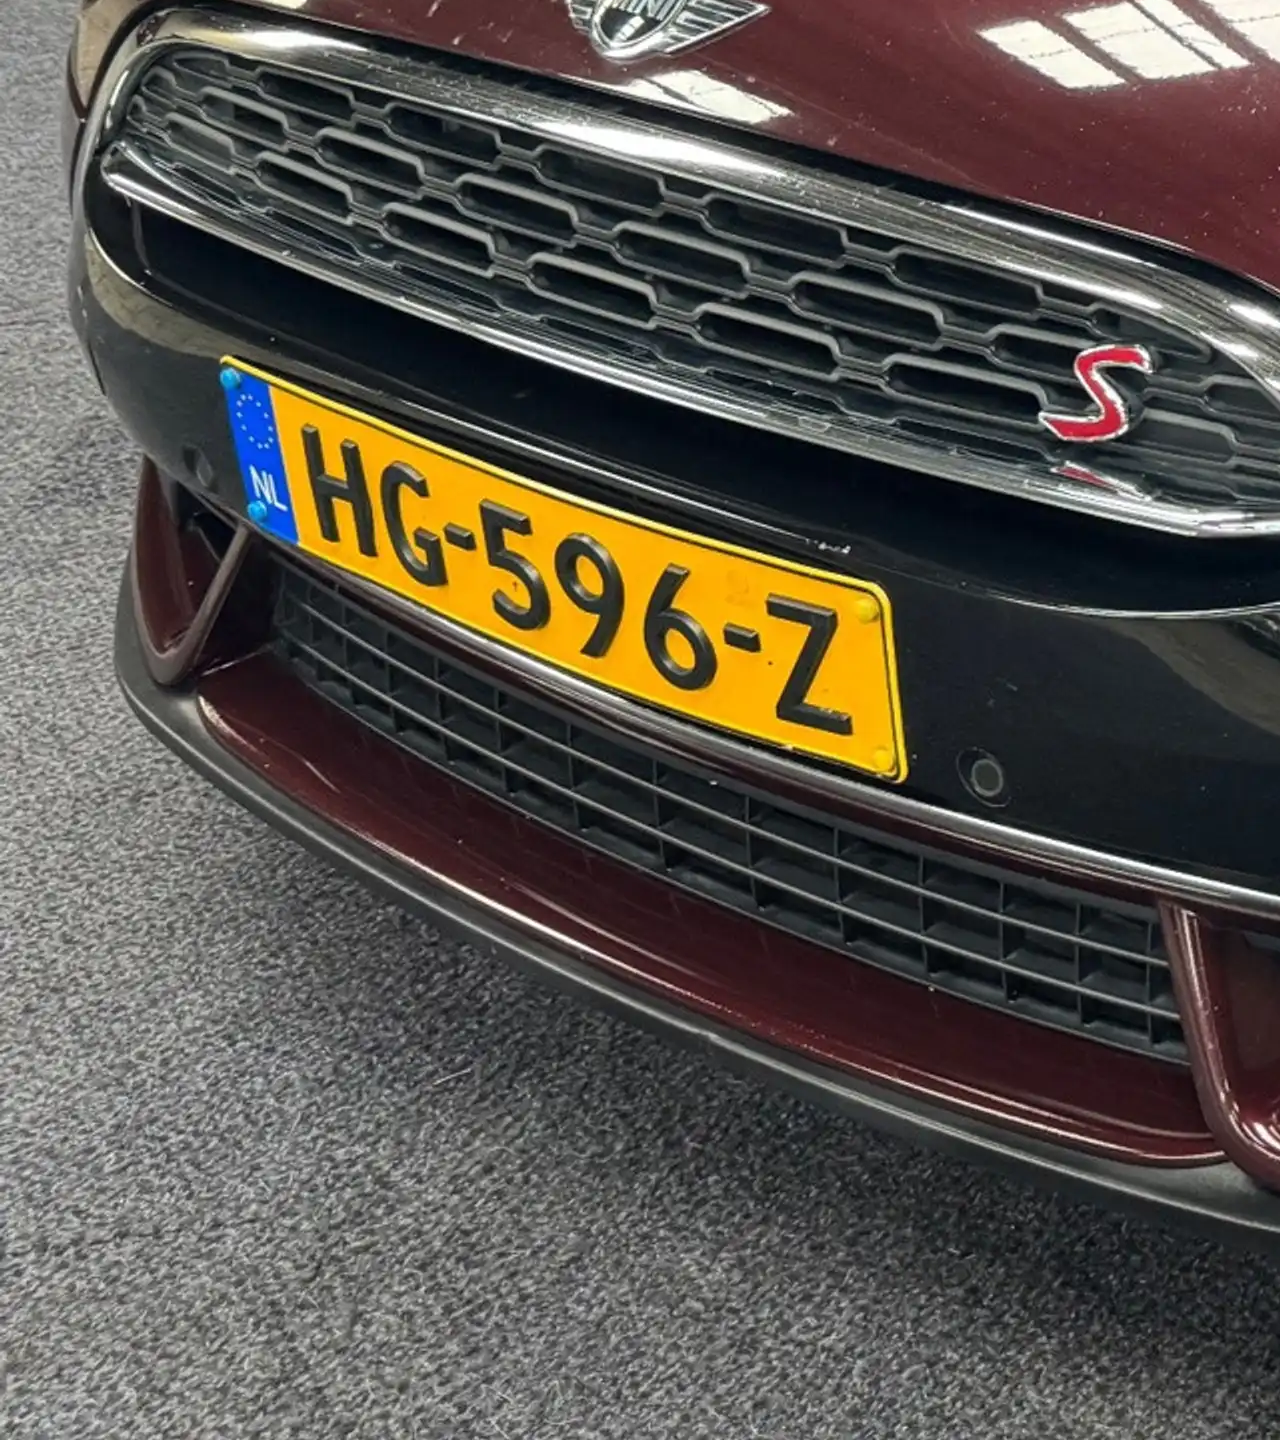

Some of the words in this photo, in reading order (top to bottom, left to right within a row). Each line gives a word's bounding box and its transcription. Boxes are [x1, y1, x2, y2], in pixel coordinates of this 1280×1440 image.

[1038, 344, 1153, 443] S
[248, 464, 288, 512] NL
[302, 424, 853, 737] HG-596-Z
